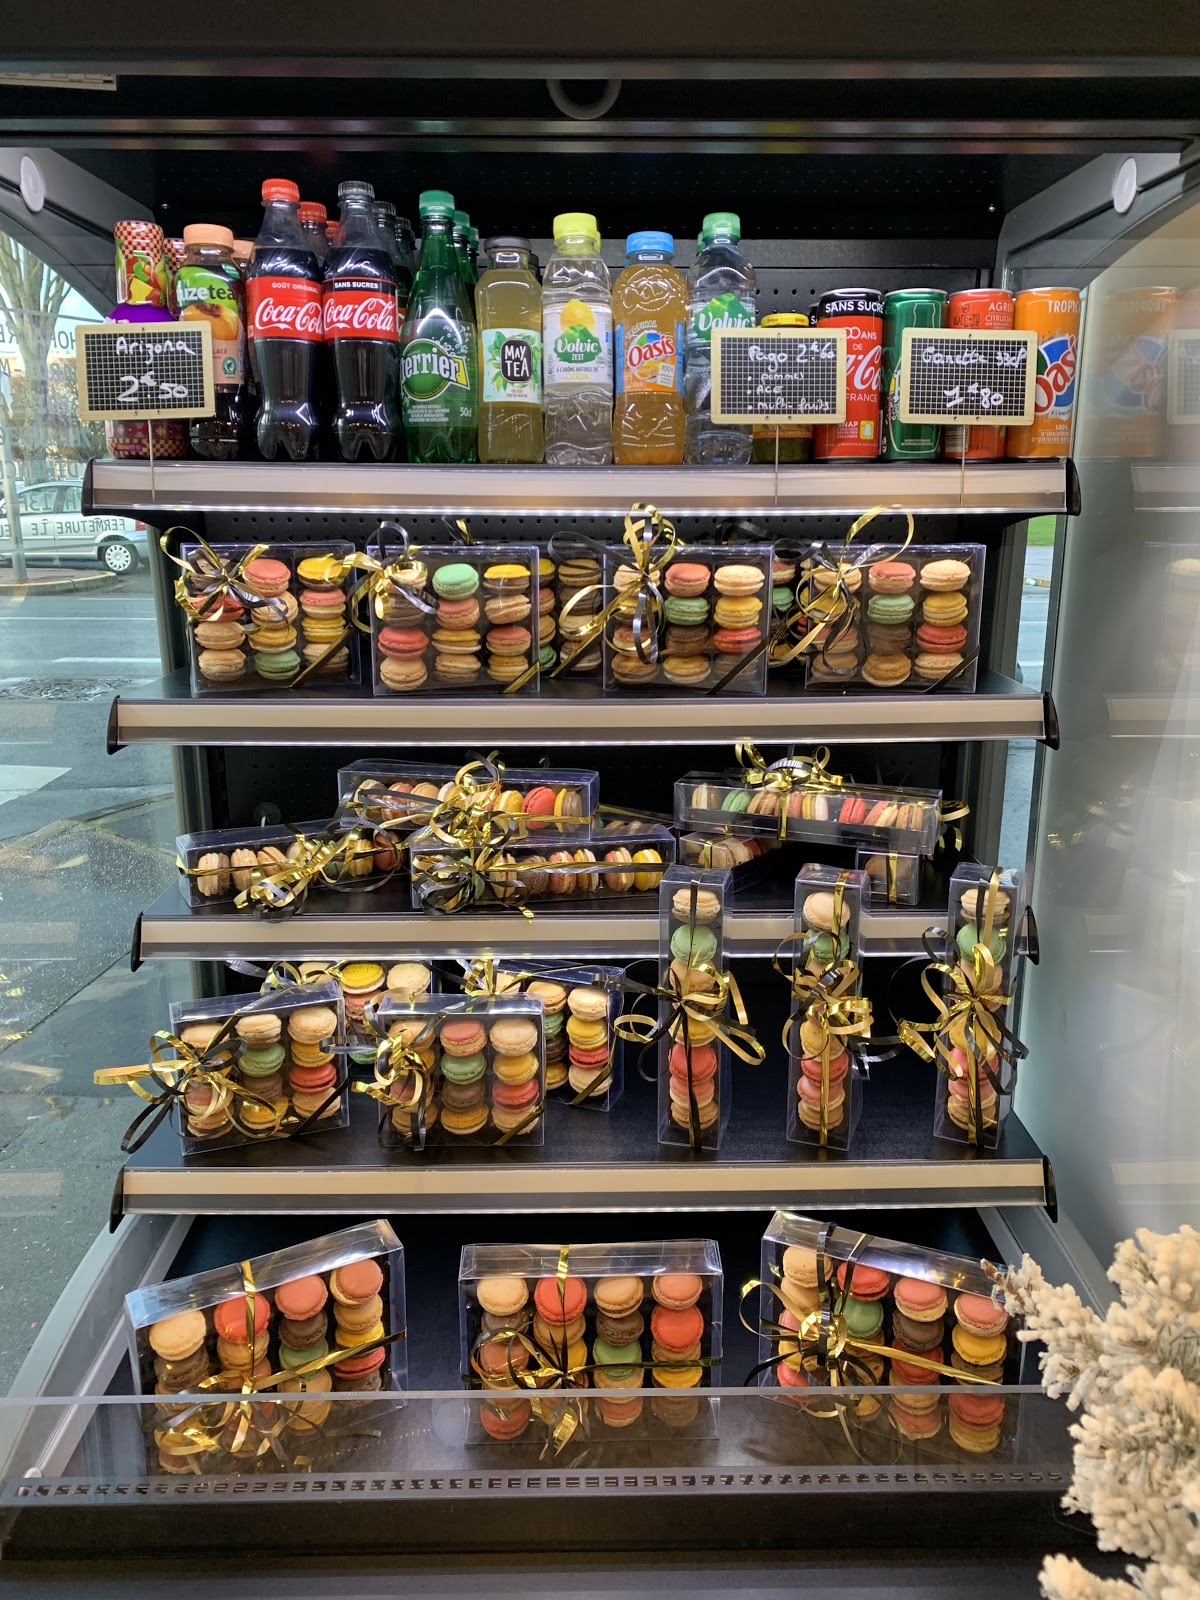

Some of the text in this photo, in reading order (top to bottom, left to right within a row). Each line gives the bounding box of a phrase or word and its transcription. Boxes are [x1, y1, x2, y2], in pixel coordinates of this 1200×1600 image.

[292, 283, 318, 294] ORIGINAL
[335, 281, 379, 289] SANS SUCRES
[323, 297, 395, 332] Coca-Cola
[825, 301, 884, 315] SANS SUCRE
[626, 319, 658, 339] TROPICAL
[115, 336, 197, 365] Arizona
[504, 344, 527, 362] MAY
[556, 337, 599, 353] Volvic
[628, 334, 676, 368] Oasis
[852, 343, 864, 351] DE
[571, 353, 585, 361] ZEST
[748, 344, 789, 373] Pago
[504, 357, 530, 378] TEA
